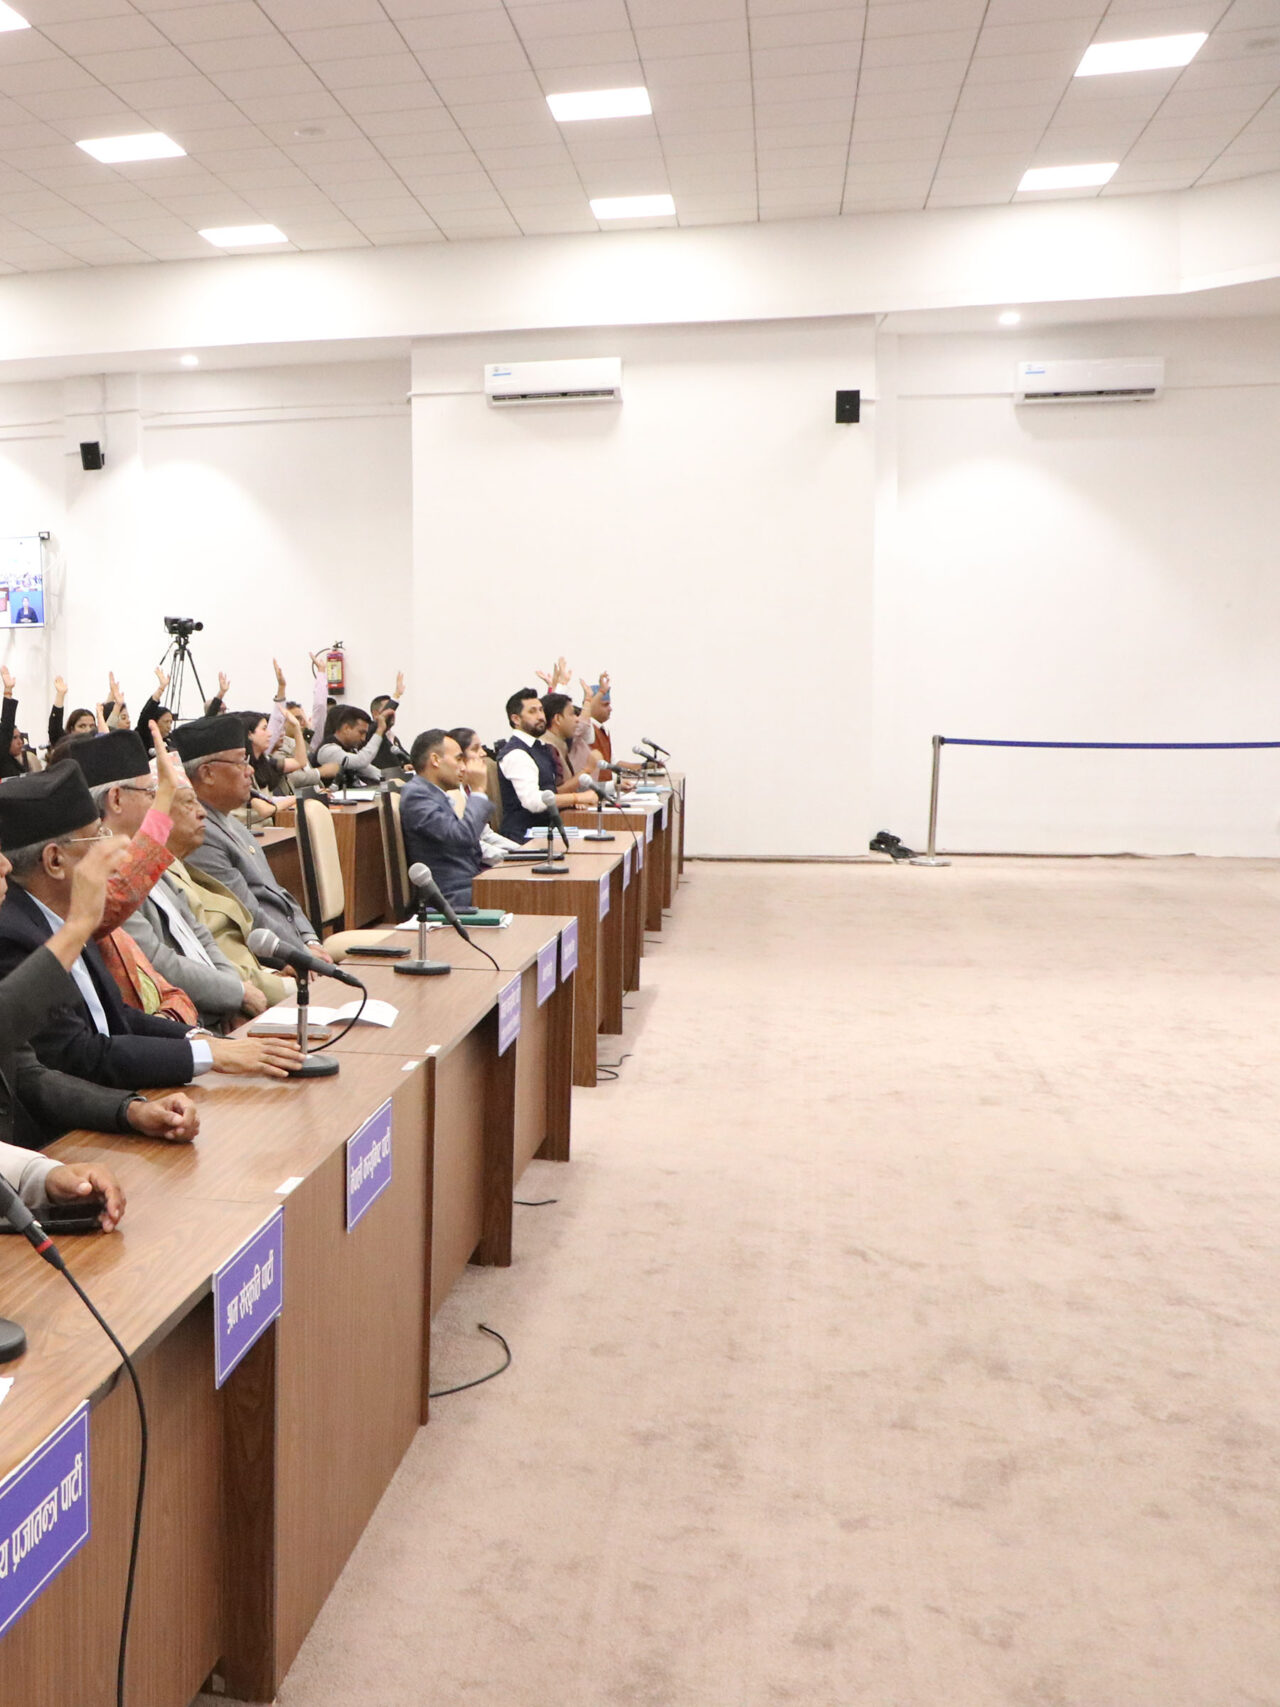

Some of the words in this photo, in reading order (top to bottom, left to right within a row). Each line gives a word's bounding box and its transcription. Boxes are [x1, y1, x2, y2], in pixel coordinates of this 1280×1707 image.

[261, 1249, 274, 1290] पार्टी
[12, 1486, 59, 1573] प्रजातन्त्र
[60, 1452, 83, 1511] पार्टी
